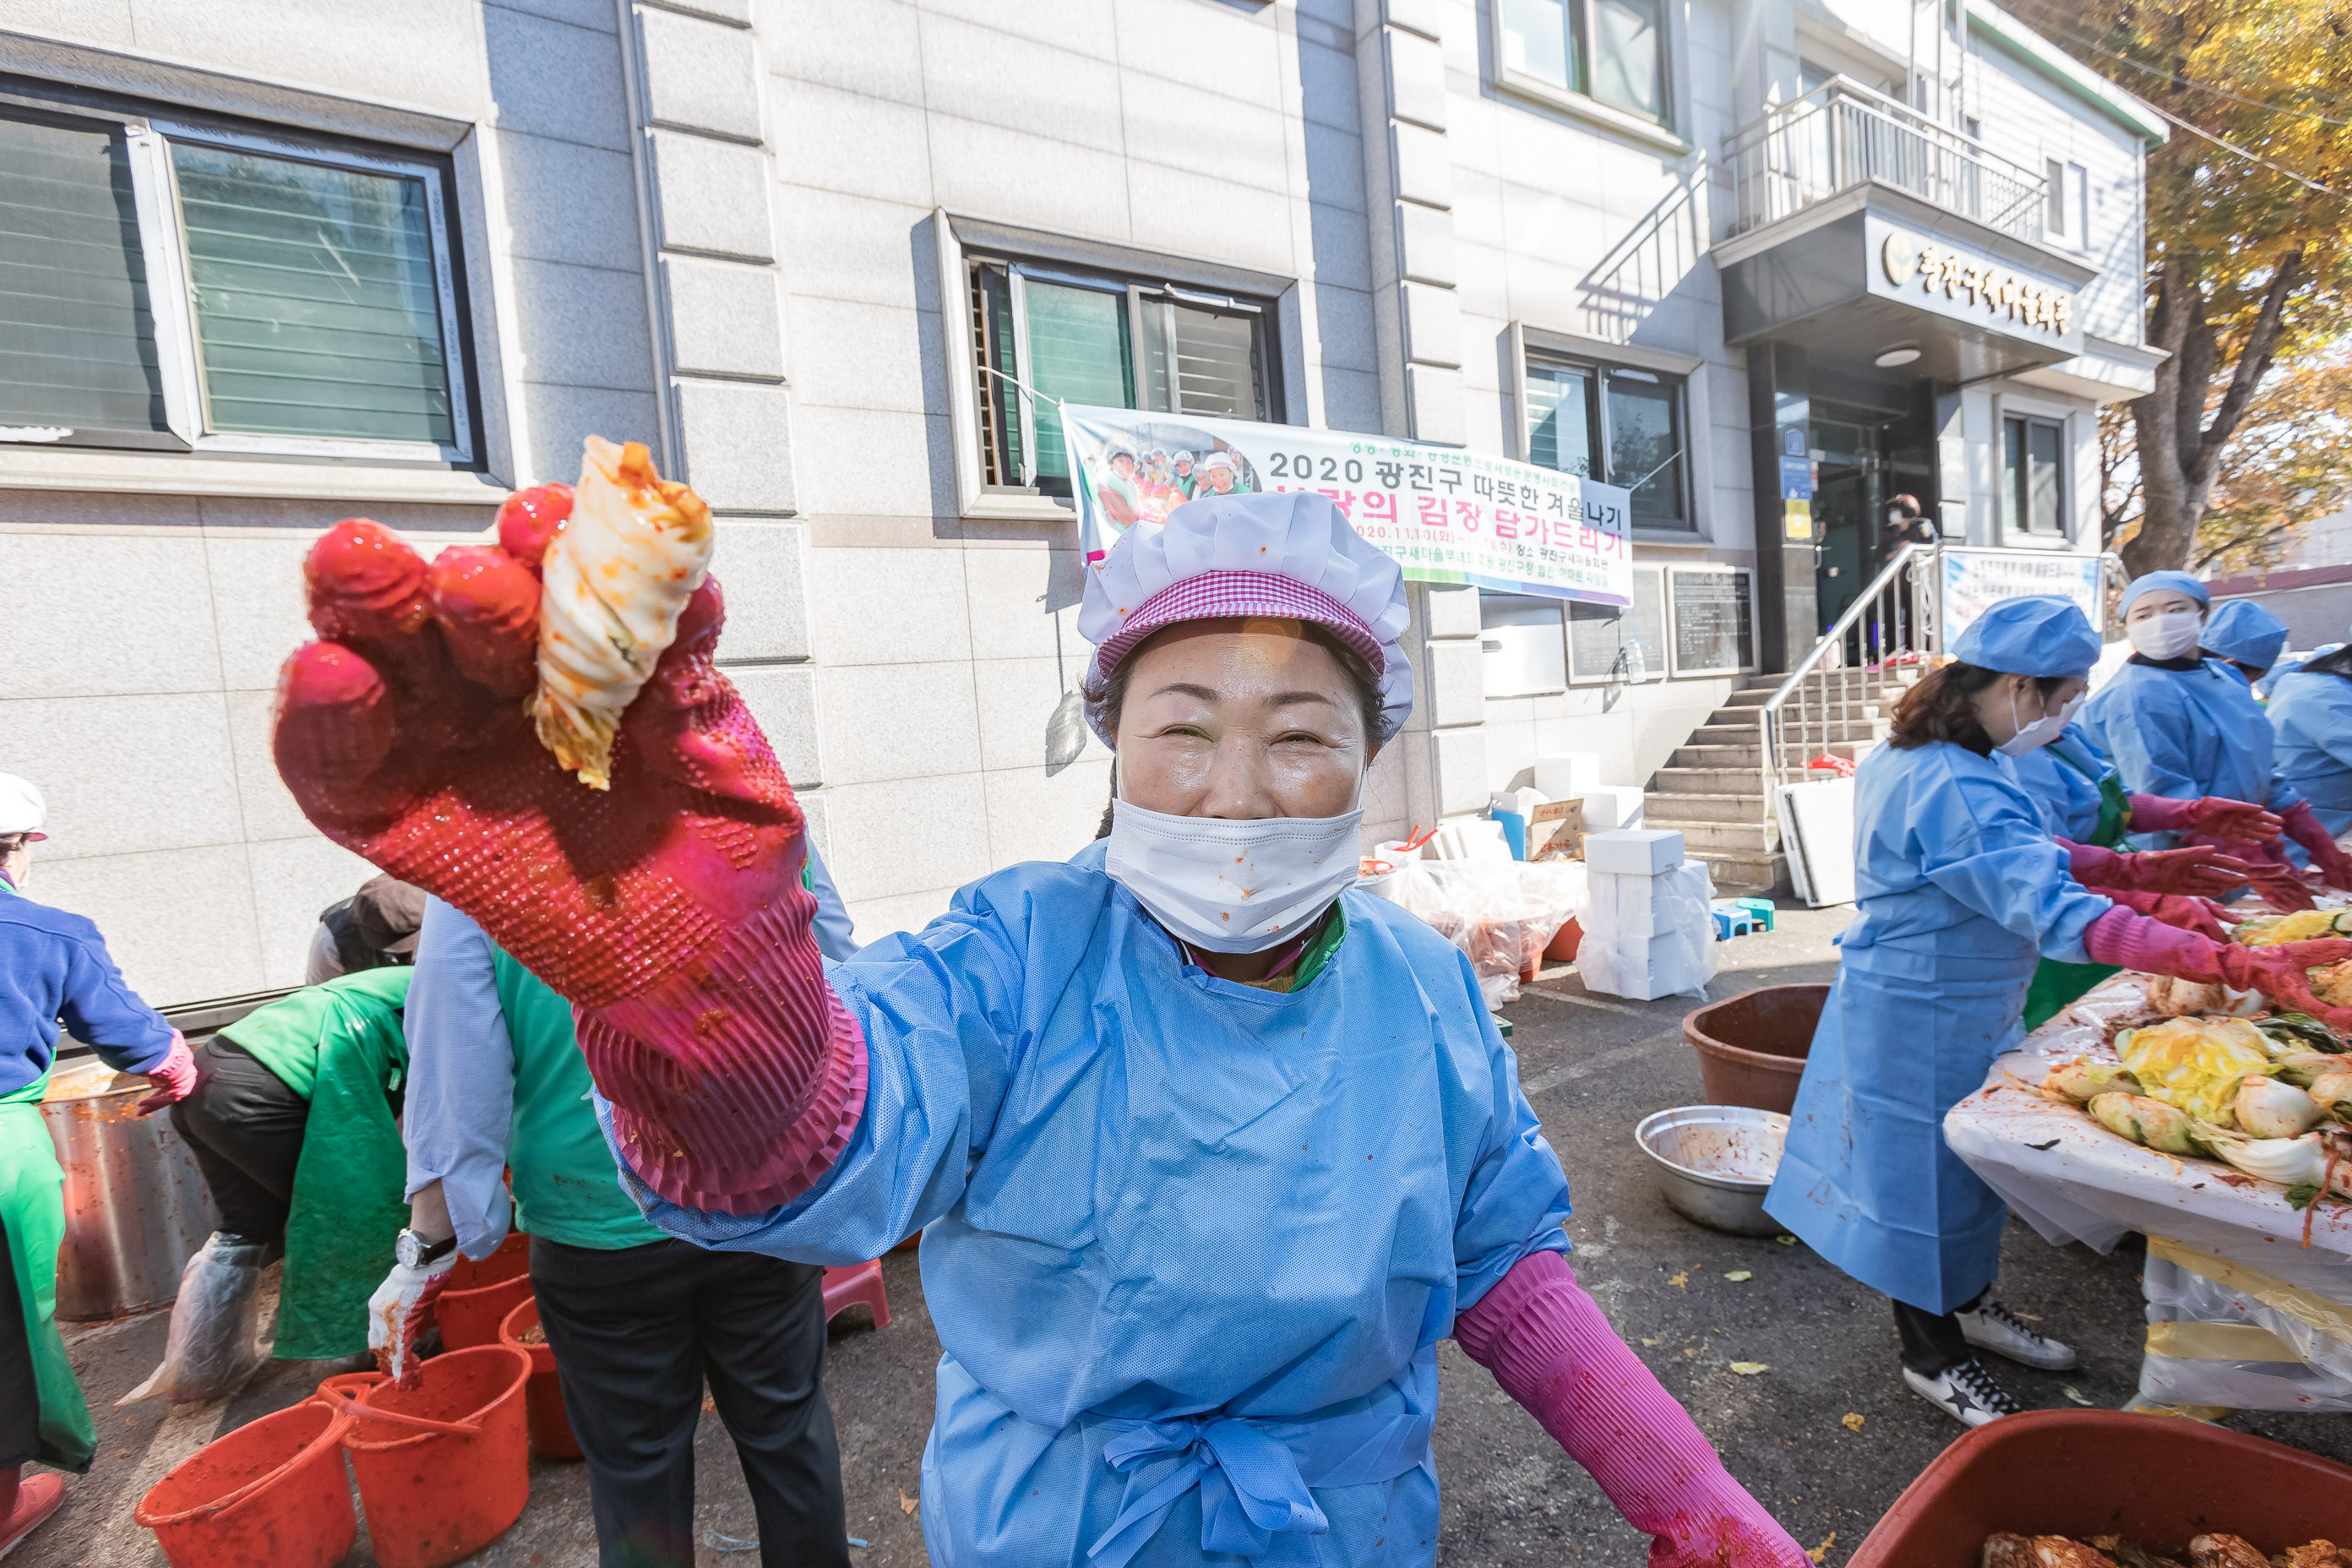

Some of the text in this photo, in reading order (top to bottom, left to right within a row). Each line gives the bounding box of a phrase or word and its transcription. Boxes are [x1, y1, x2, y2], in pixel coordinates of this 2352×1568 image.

[1270, 452, 1621, 531] 2020 광진구 따뜻한 겨울나기
[1277, 486, 1623, 559] 랑의 김장 담가드리기
